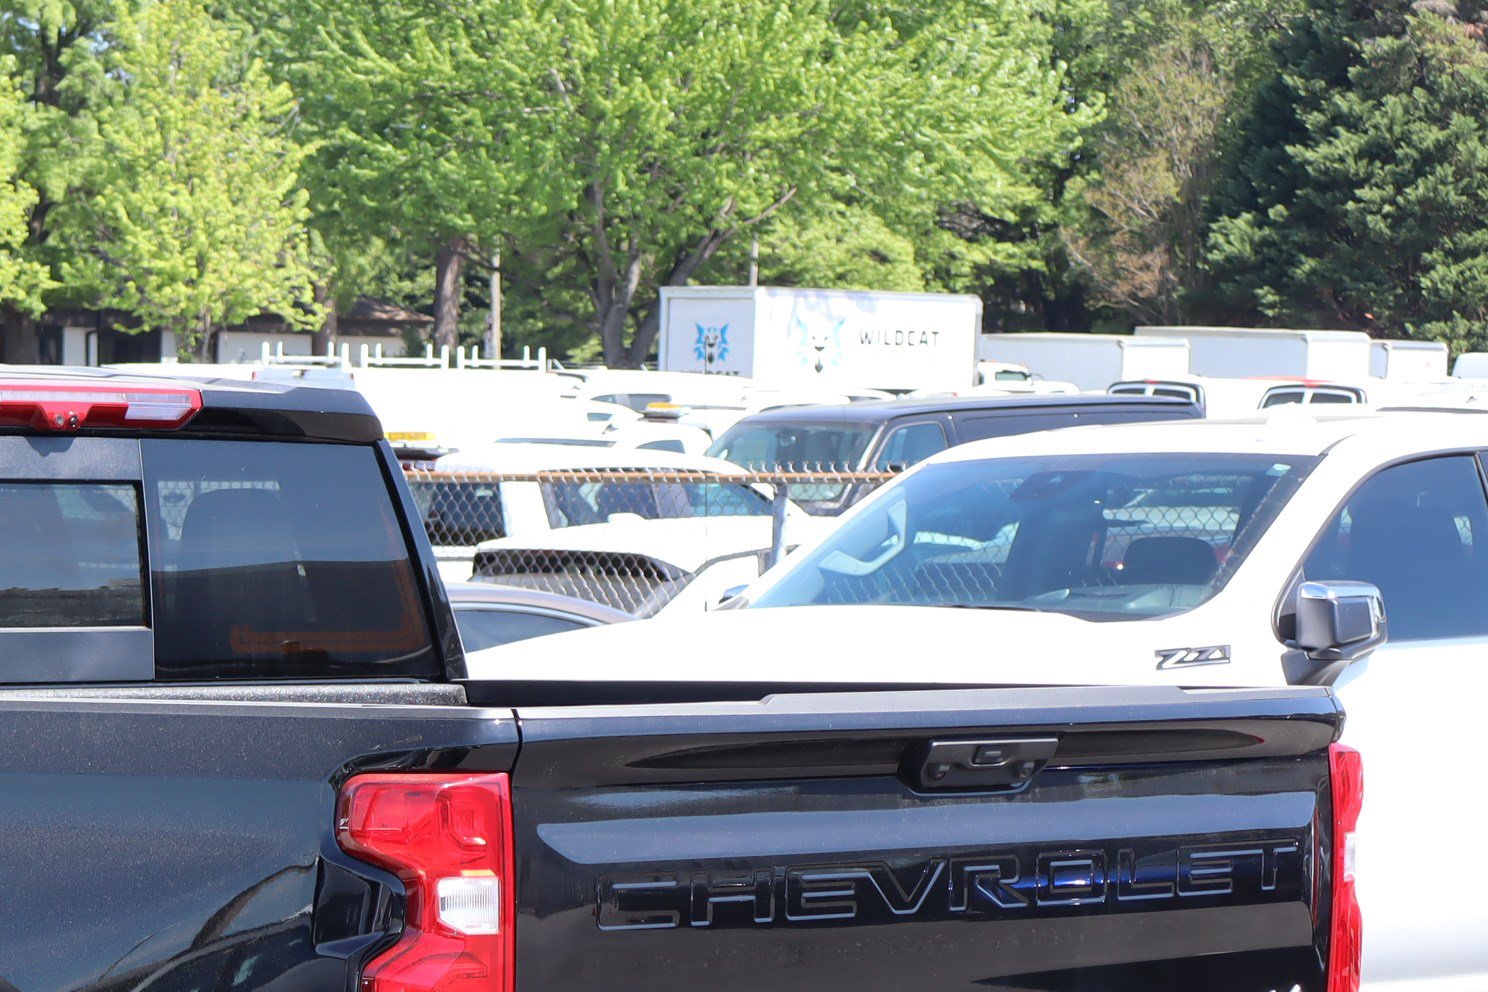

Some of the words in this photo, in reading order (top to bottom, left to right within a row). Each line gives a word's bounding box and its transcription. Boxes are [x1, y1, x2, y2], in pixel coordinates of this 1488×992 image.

[859, 329, 940, 346] WILDCAT
[1155, 644, 1231, 671] Z71
[598, 840, 1300, 931] CHEVROLET
